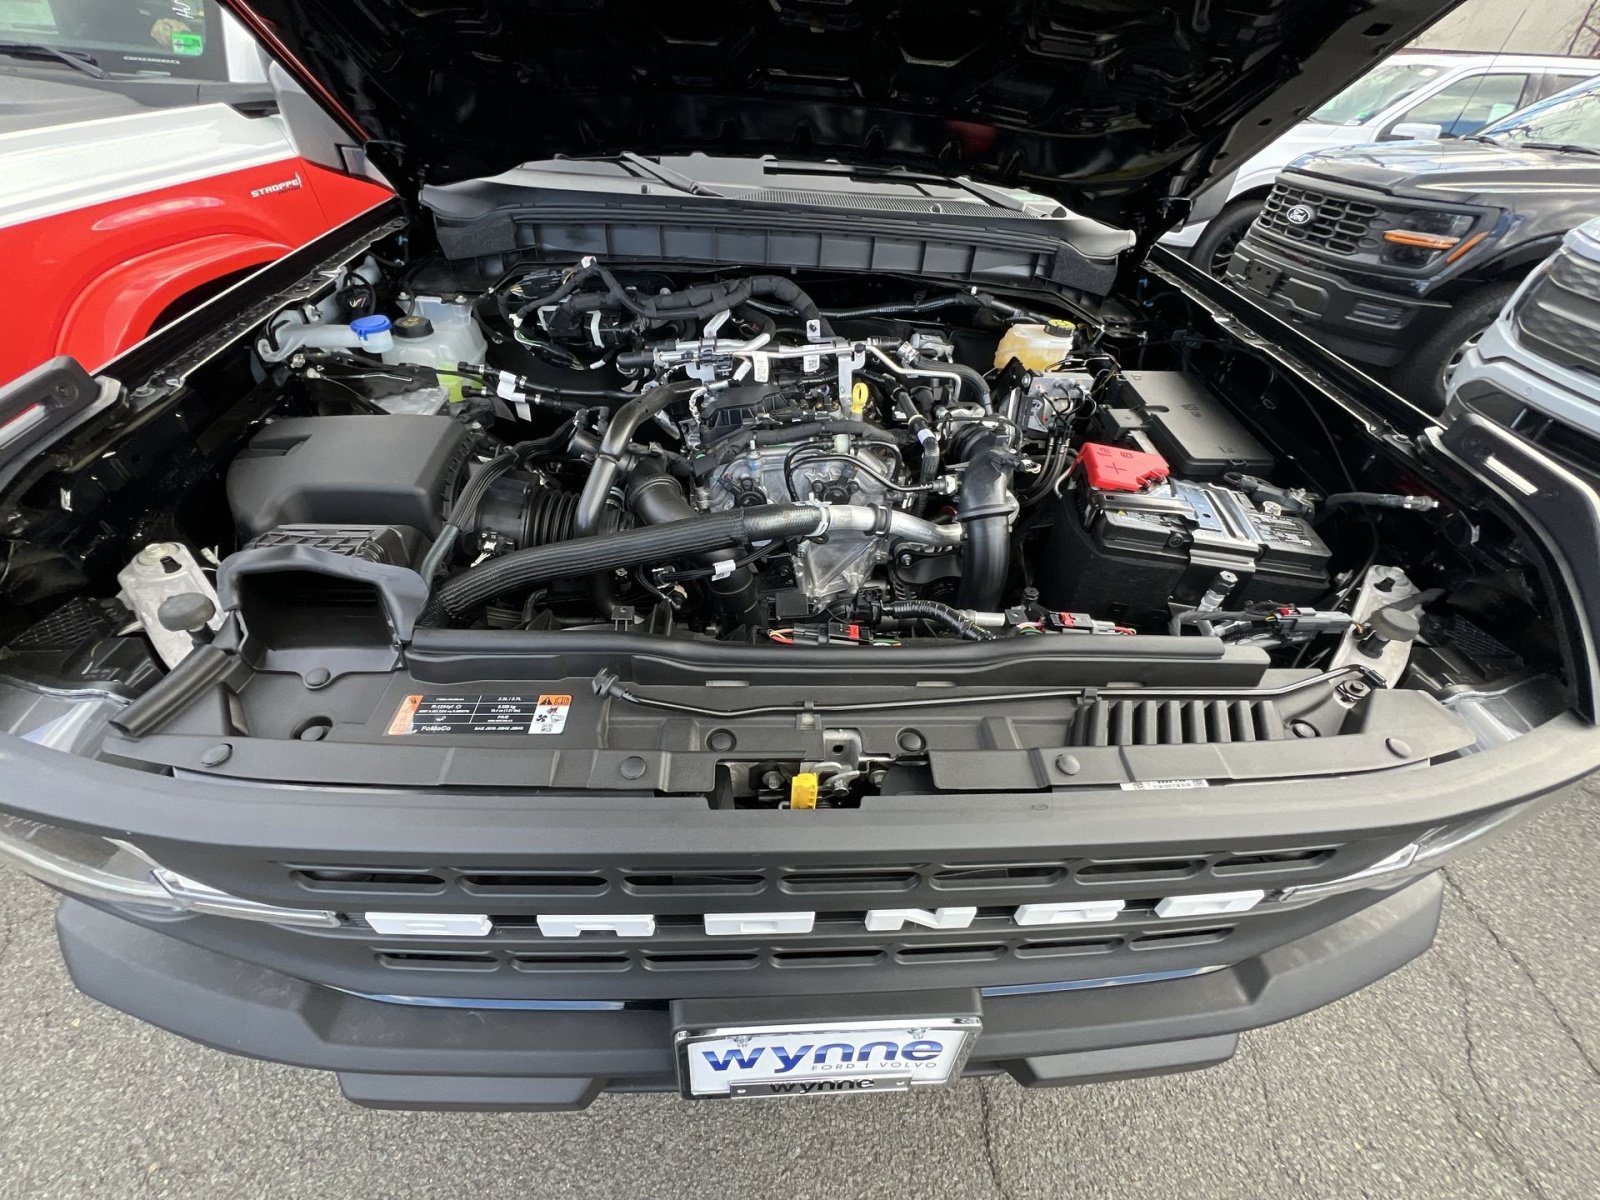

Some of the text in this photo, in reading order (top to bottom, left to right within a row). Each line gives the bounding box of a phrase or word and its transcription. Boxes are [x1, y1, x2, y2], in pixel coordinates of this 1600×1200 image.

[250, 179, 300, 198] STROPPE
[702, 1040, 943, 1074] wynne
[811, 1062, 855, 1072] FORD
[879, 1060, 938, 1069] VOLVO
[769, 1078, 875, 1094] wynne
